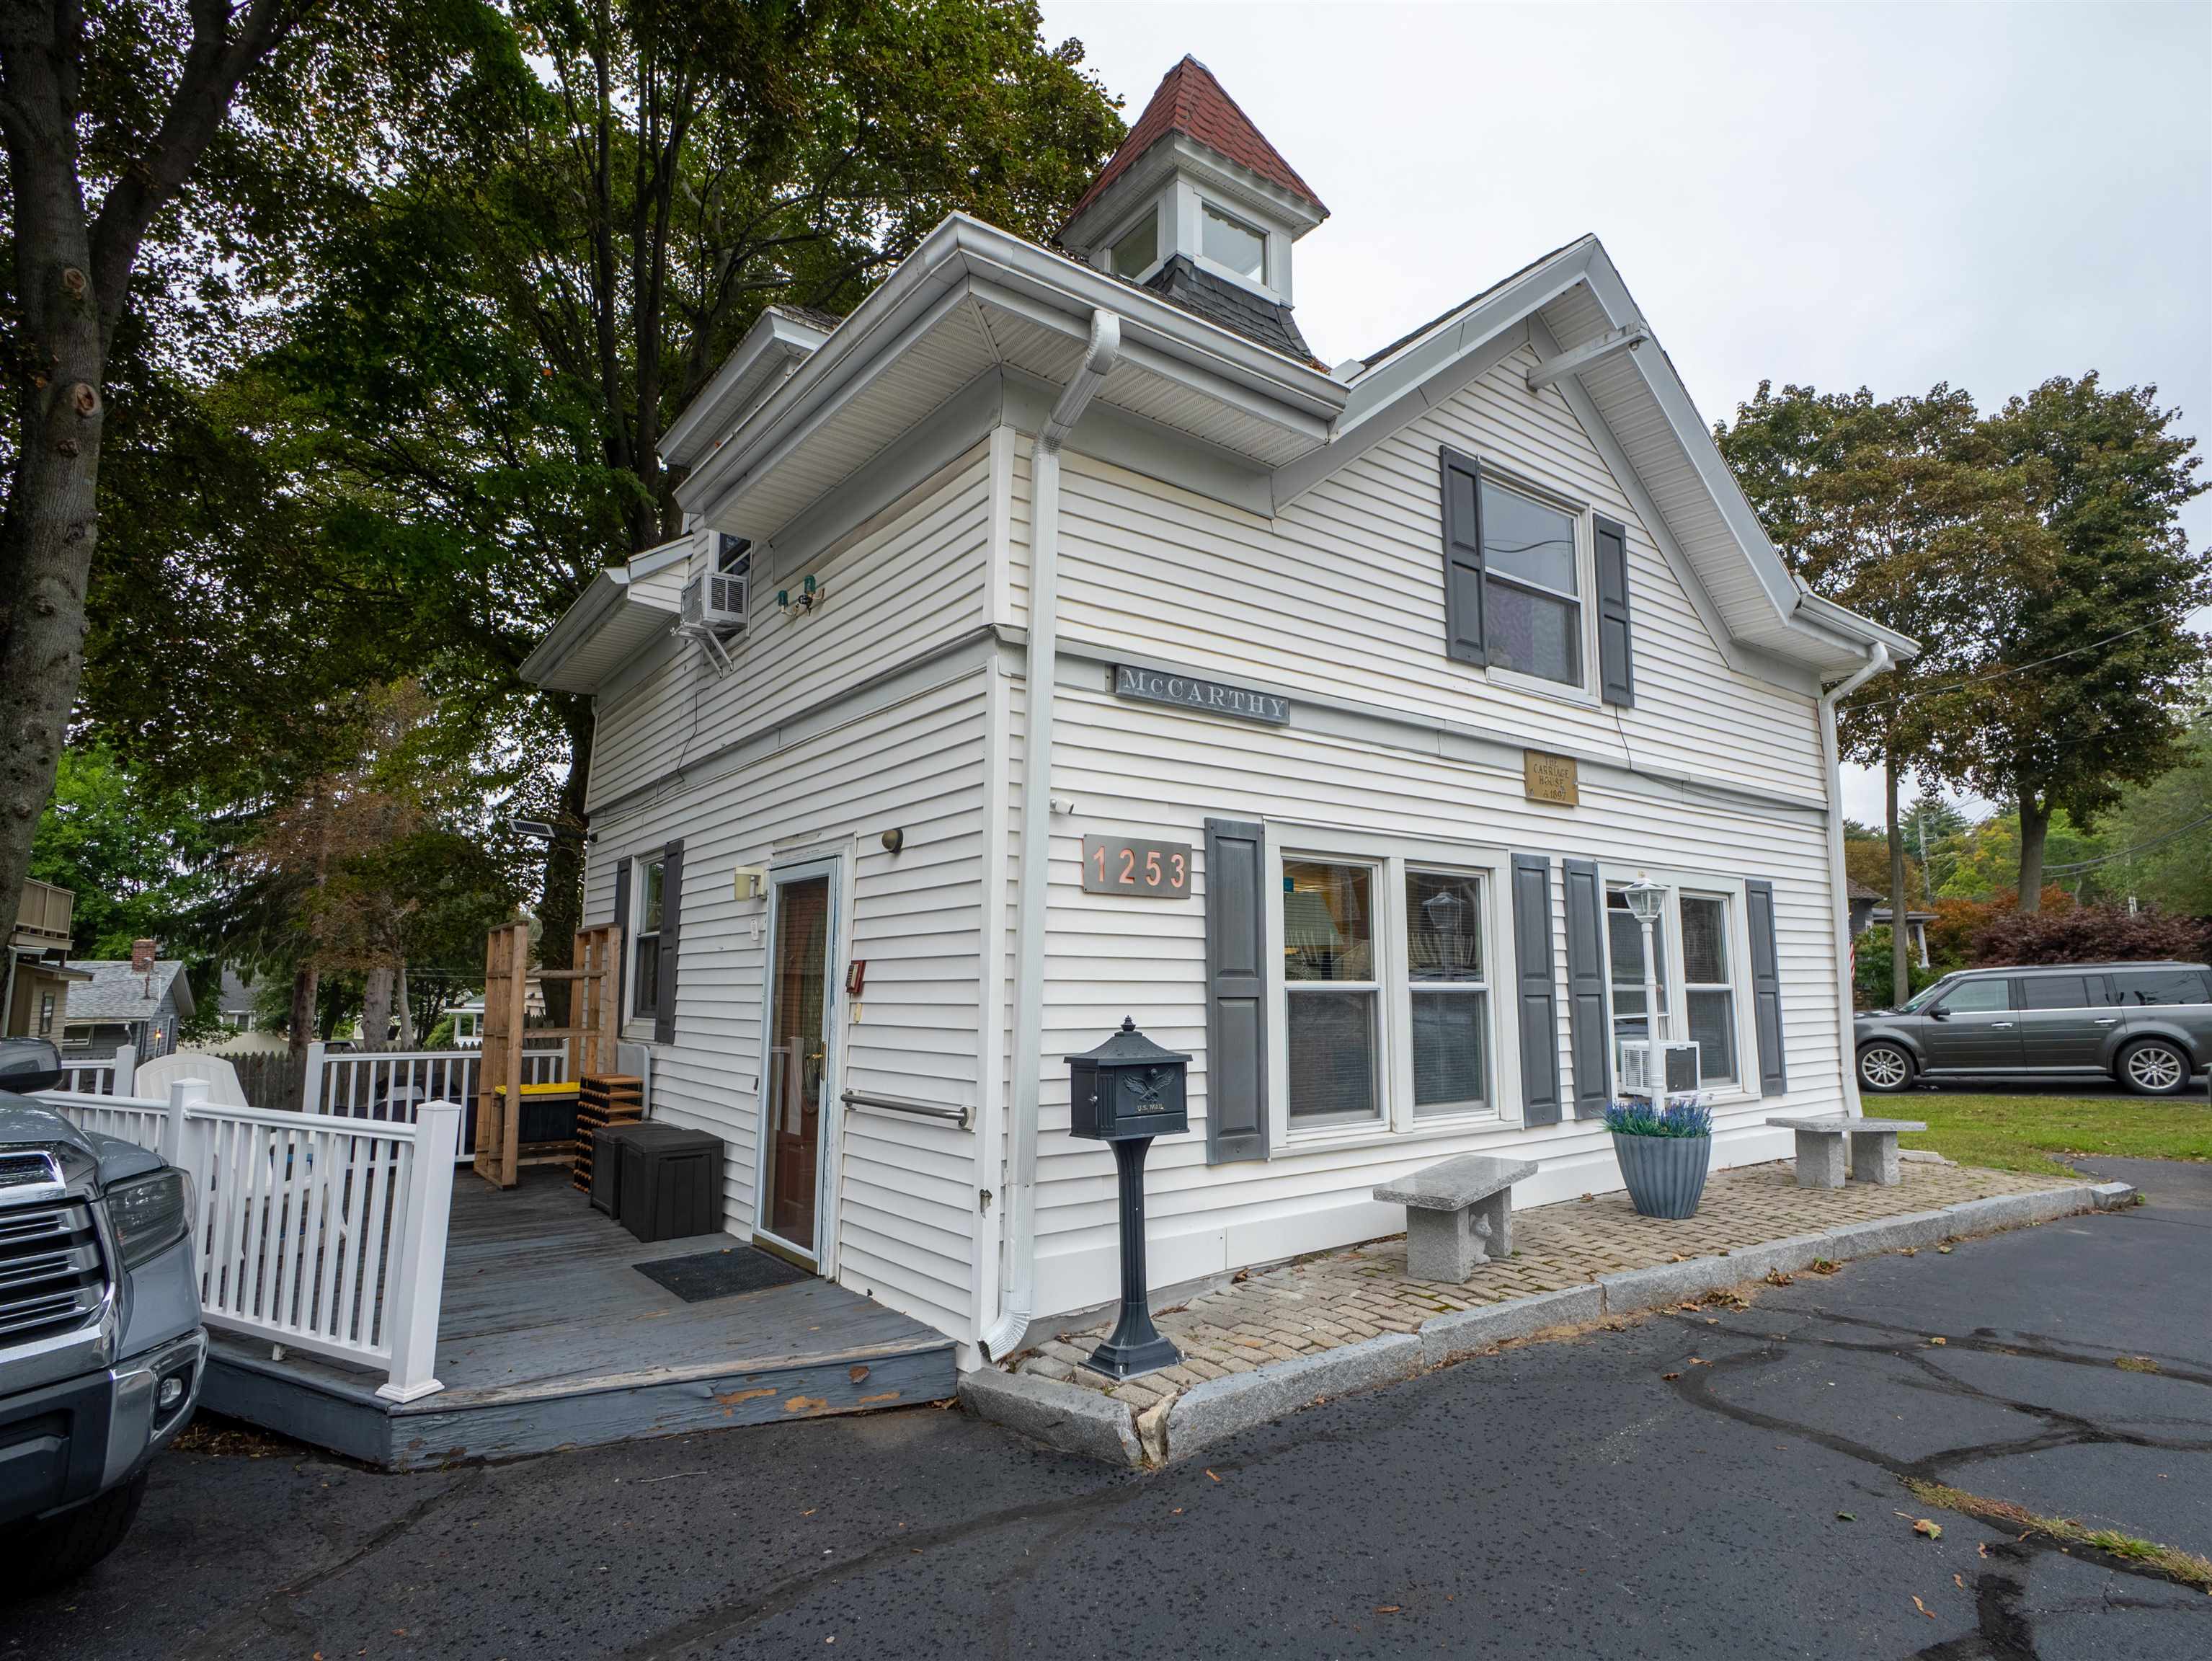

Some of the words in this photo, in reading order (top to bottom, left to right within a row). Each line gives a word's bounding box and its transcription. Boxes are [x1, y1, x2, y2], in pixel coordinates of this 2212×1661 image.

[1533, 763, 1570, 779] CARRIAGE
[1539, 775, 1563, 787] HOUSE
[1093, 845, 1185, 888] 1253
